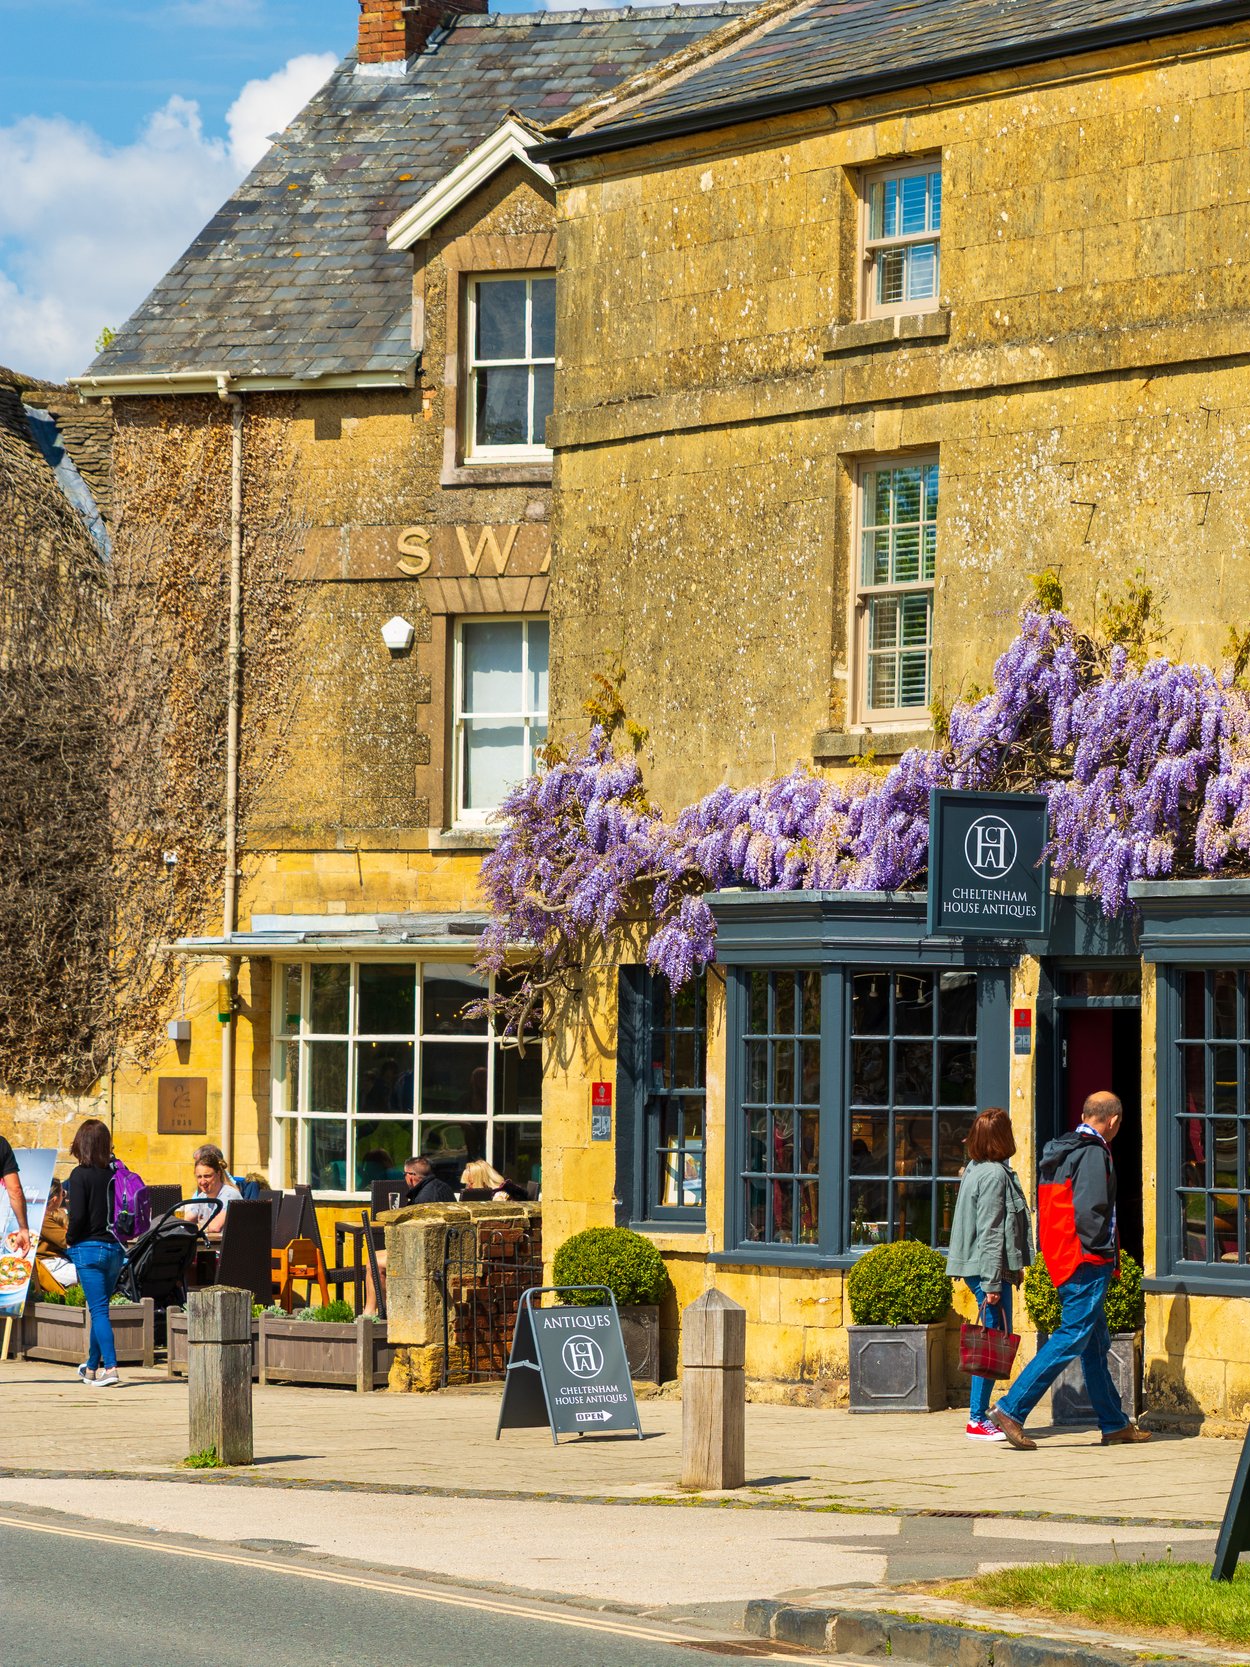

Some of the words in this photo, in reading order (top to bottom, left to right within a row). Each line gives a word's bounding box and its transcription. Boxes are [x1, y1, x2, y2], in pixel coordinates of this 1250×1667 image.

[396, 525, 551, 576] SW
[952, 887, 1028, 902] CHELTENHAM
[943, 901, 980, 914] HOUSE
[982, 904, 1037, 918] ANTIQUES
[543, 1314, 611, 1330] ANTIQUES
[559, 1384, 619, 1395] CHELTENHAM
[555, 1396, 584, 1405] HOUSE
[585, 1393, 628, 1404] ANTIQUES
[576, 1411, 605, 1421] OPEN
